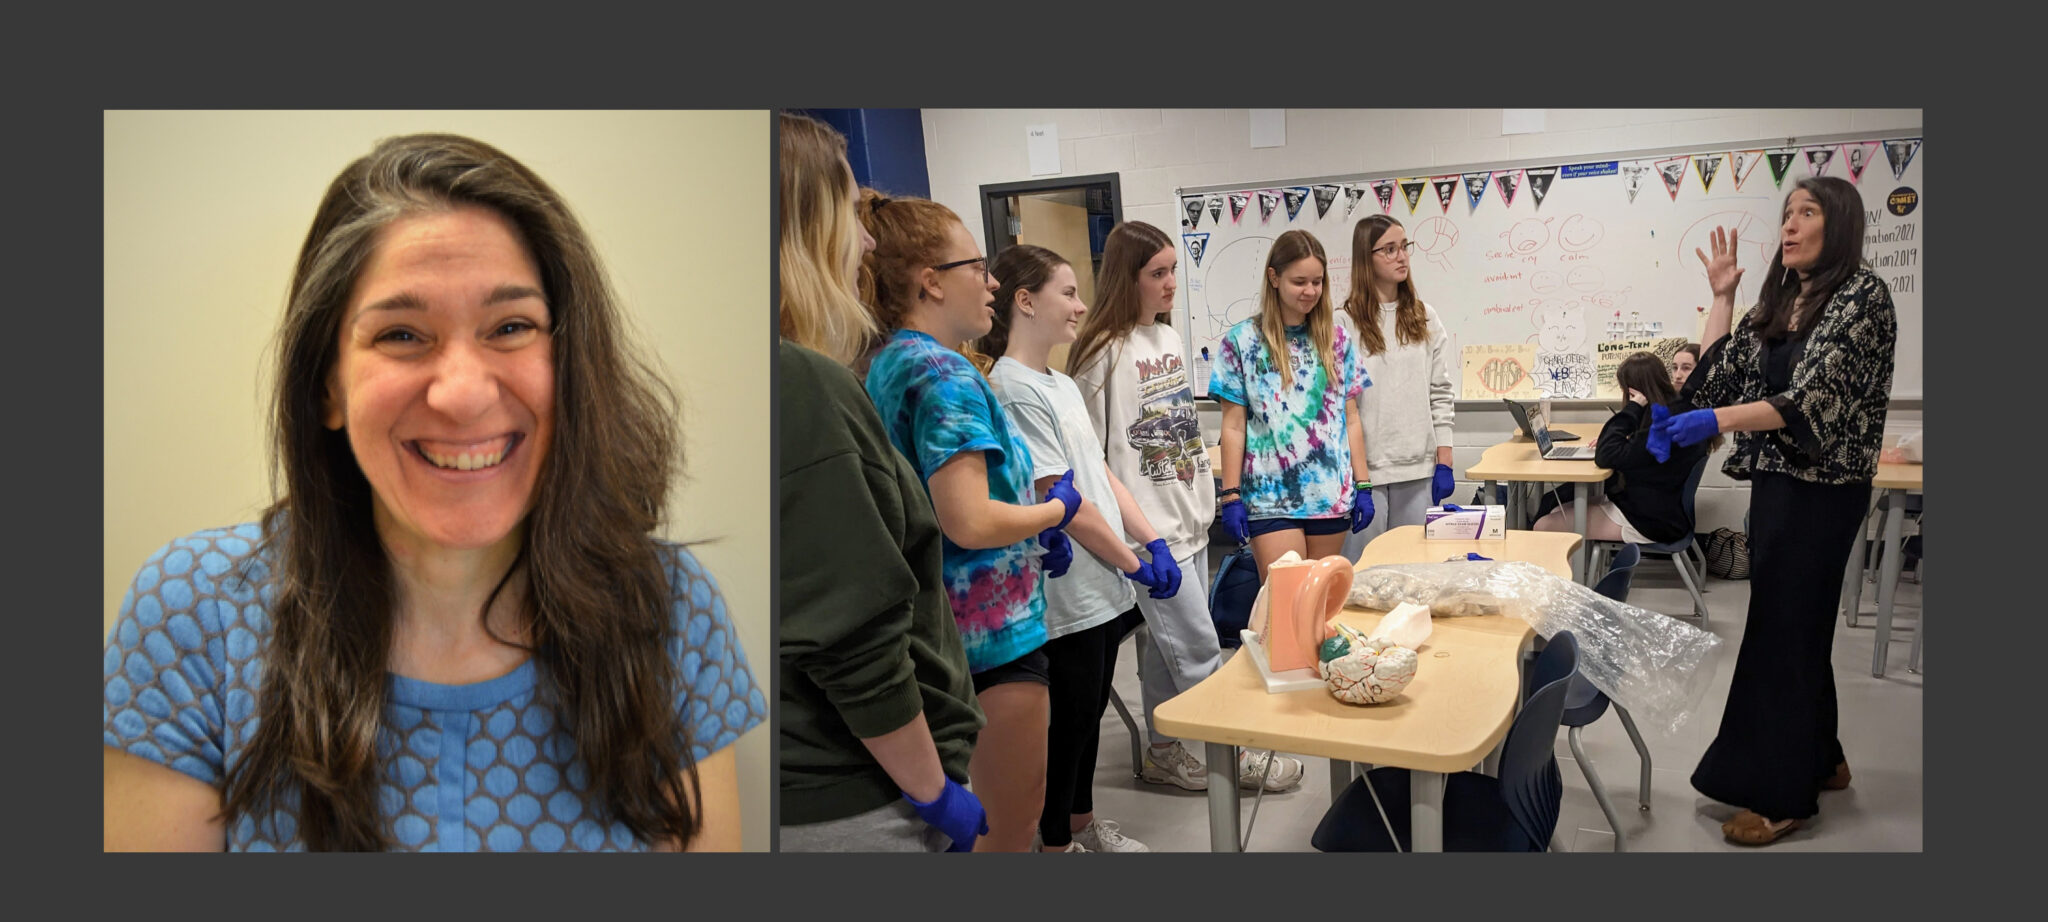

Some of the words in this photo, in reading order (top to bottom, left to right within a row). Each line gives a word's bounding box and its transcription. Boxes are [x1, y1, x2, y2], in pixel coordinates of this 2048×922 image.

[1865, 223, 1916, 244] nation2021
[1868, 248, 1918, 269] ation2019
[1554, 381, 1577, 394] LAW
